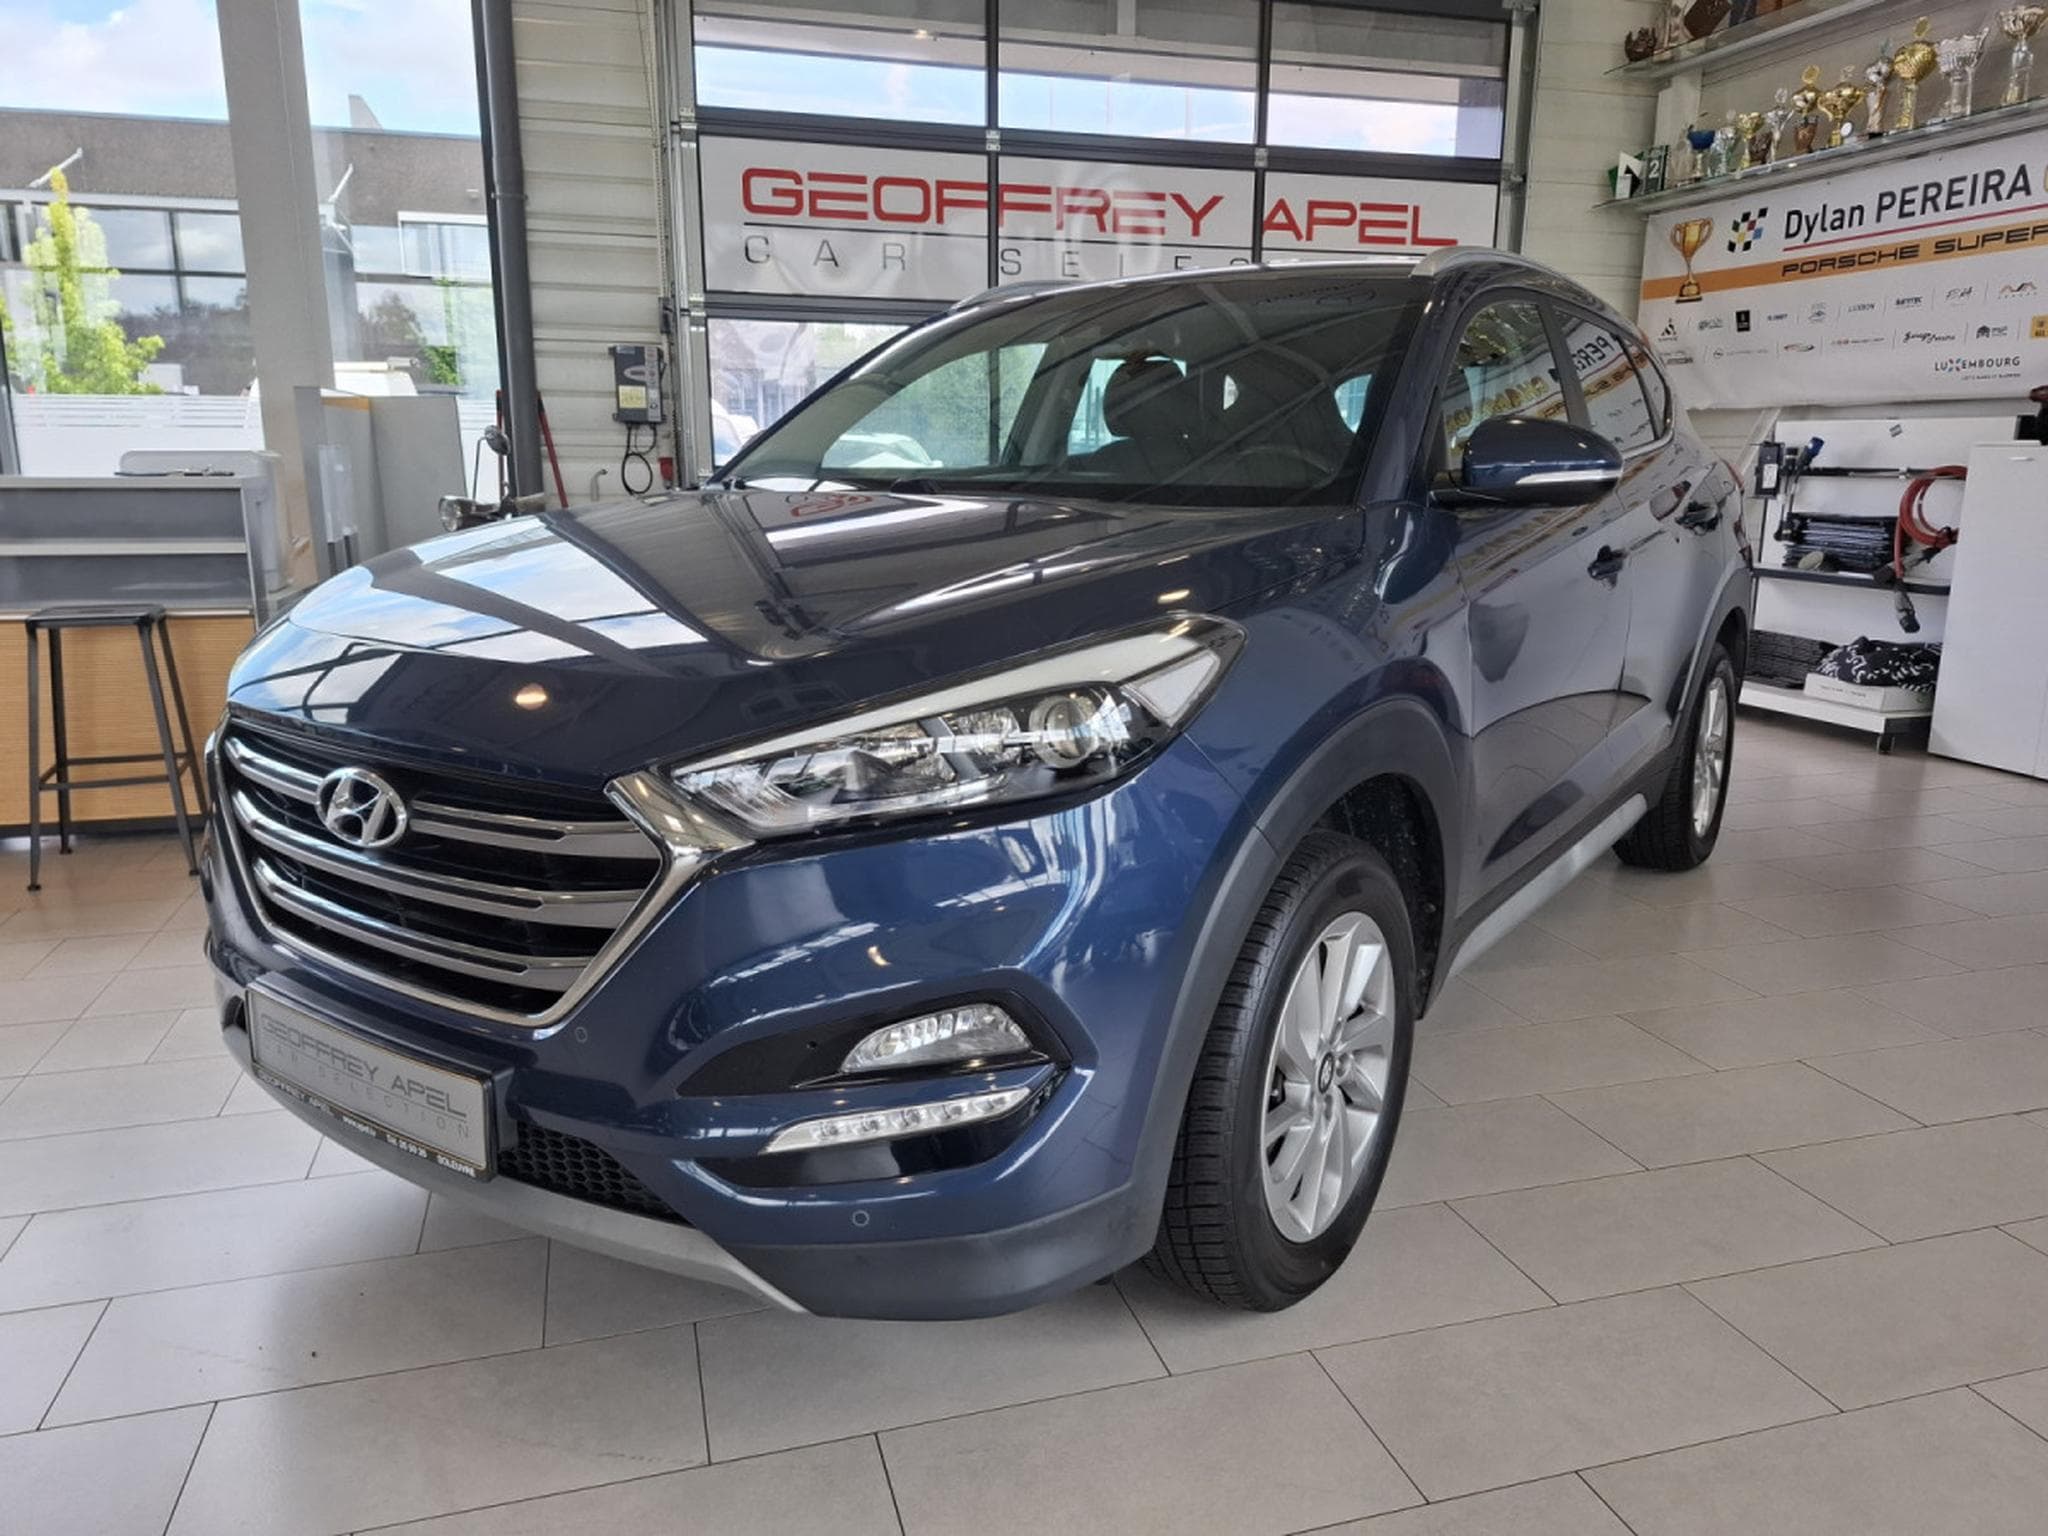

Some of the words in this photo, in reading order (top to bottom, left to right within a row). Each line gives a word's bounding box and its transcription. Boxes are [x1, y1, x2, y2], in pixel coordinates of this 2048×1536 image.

[742, 168, 1225, 238] GEOFFREY
[1262, 198, 1458, 246] APEL
[1784, 204, 1865, 243] Dylan
[1875, 164, 2032, 223] PEREIRA
[744, 235, 906, 272] CAR
[1782, 245, 1920, 277] PORSCHE
[1935, 356, 2021, 373] LUXEMBOURG
[261, 1013, 379, 1082] GEOFFREY
[392, 1075, 467, 1118] APEL
